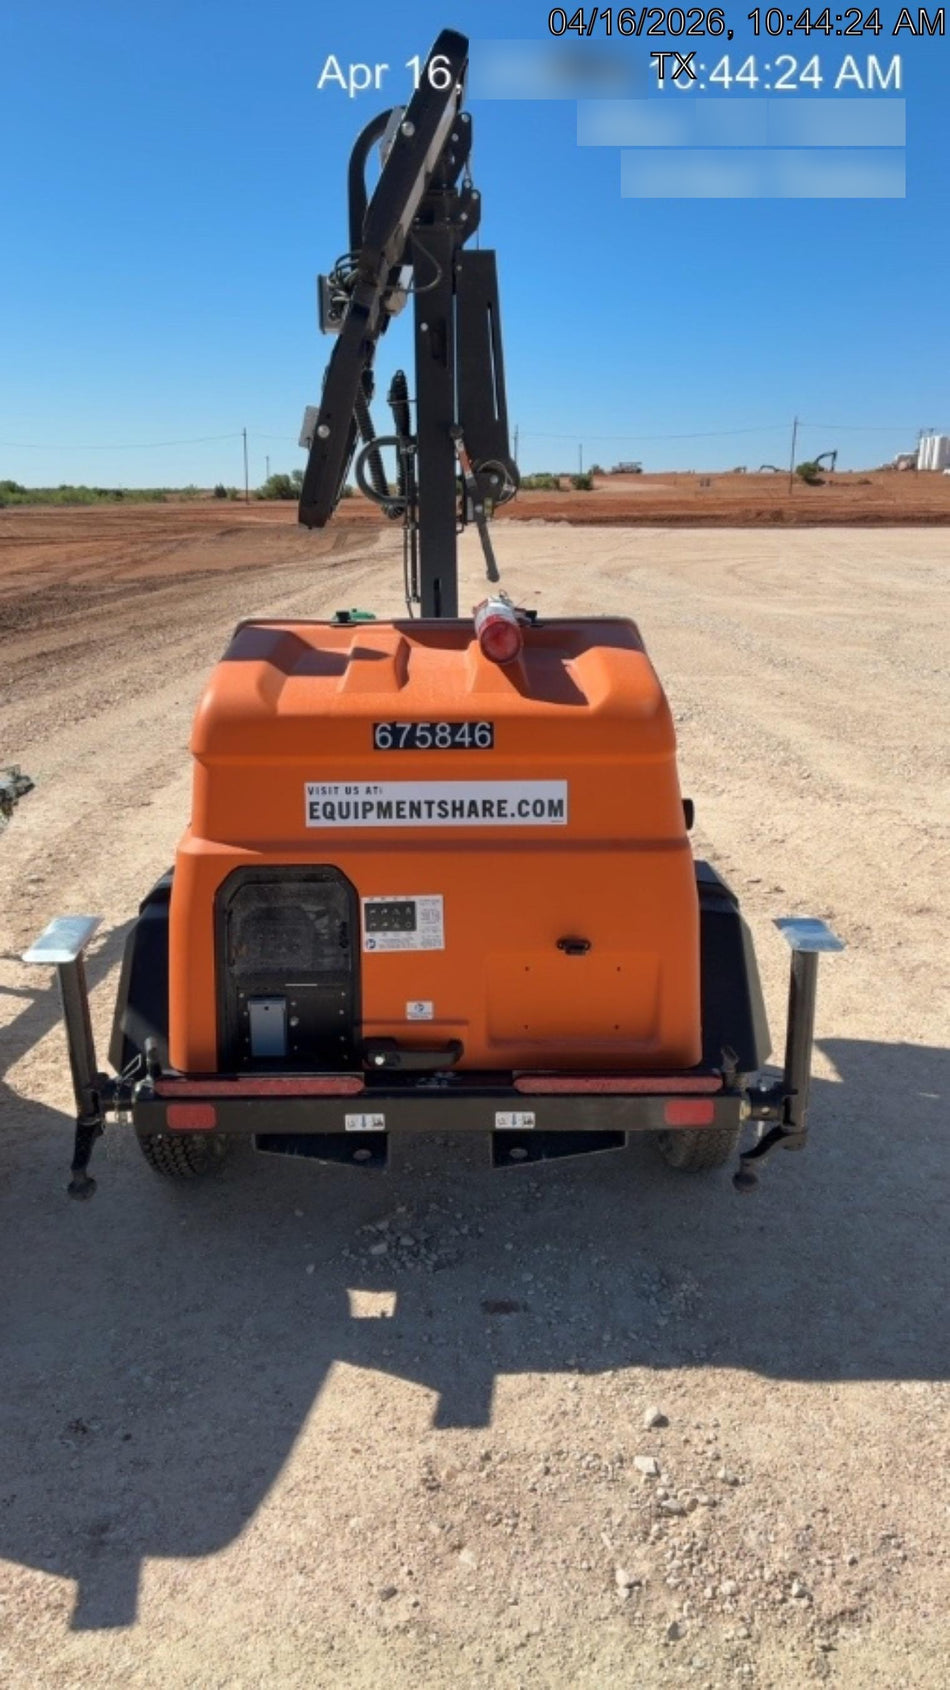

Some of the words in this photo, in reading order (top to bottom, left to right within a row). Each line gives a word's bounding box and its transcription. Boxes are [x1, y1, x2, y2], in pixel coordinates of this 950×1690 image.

[374, 722, 492, 748] 675846
[307, 786, 339, 795] VISIT
[345, 786, 359, 795] US
[308, 799, 564, 821] EQUIPMENTSHARE.COM
